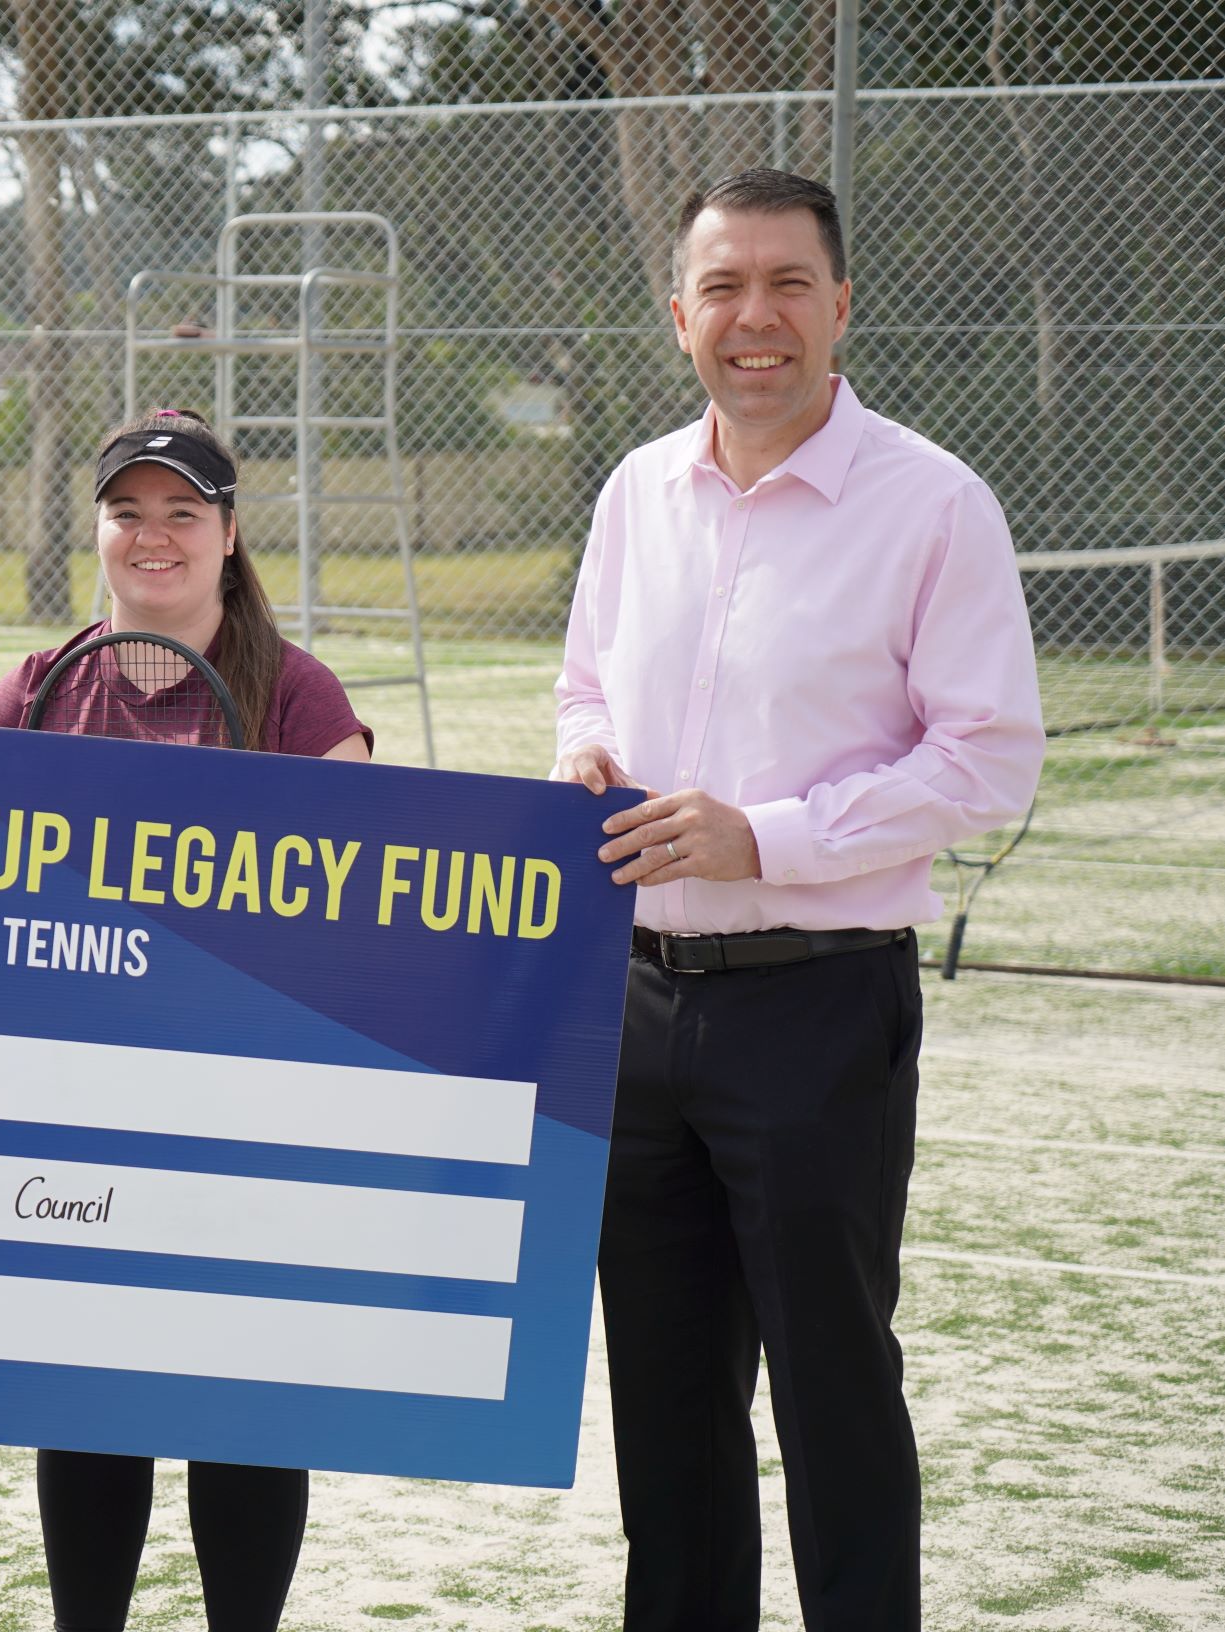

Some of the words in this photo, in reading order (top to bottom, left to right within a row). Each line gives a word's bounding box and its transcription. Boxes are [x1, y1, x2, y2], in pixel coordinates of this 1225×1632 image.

[88, 816, 362, 921] LEGACY
[378, 844, 562, 939] FUND
[3, 917, 150, 977] TENNIS
[15, 1176, 114, 1223] Council
